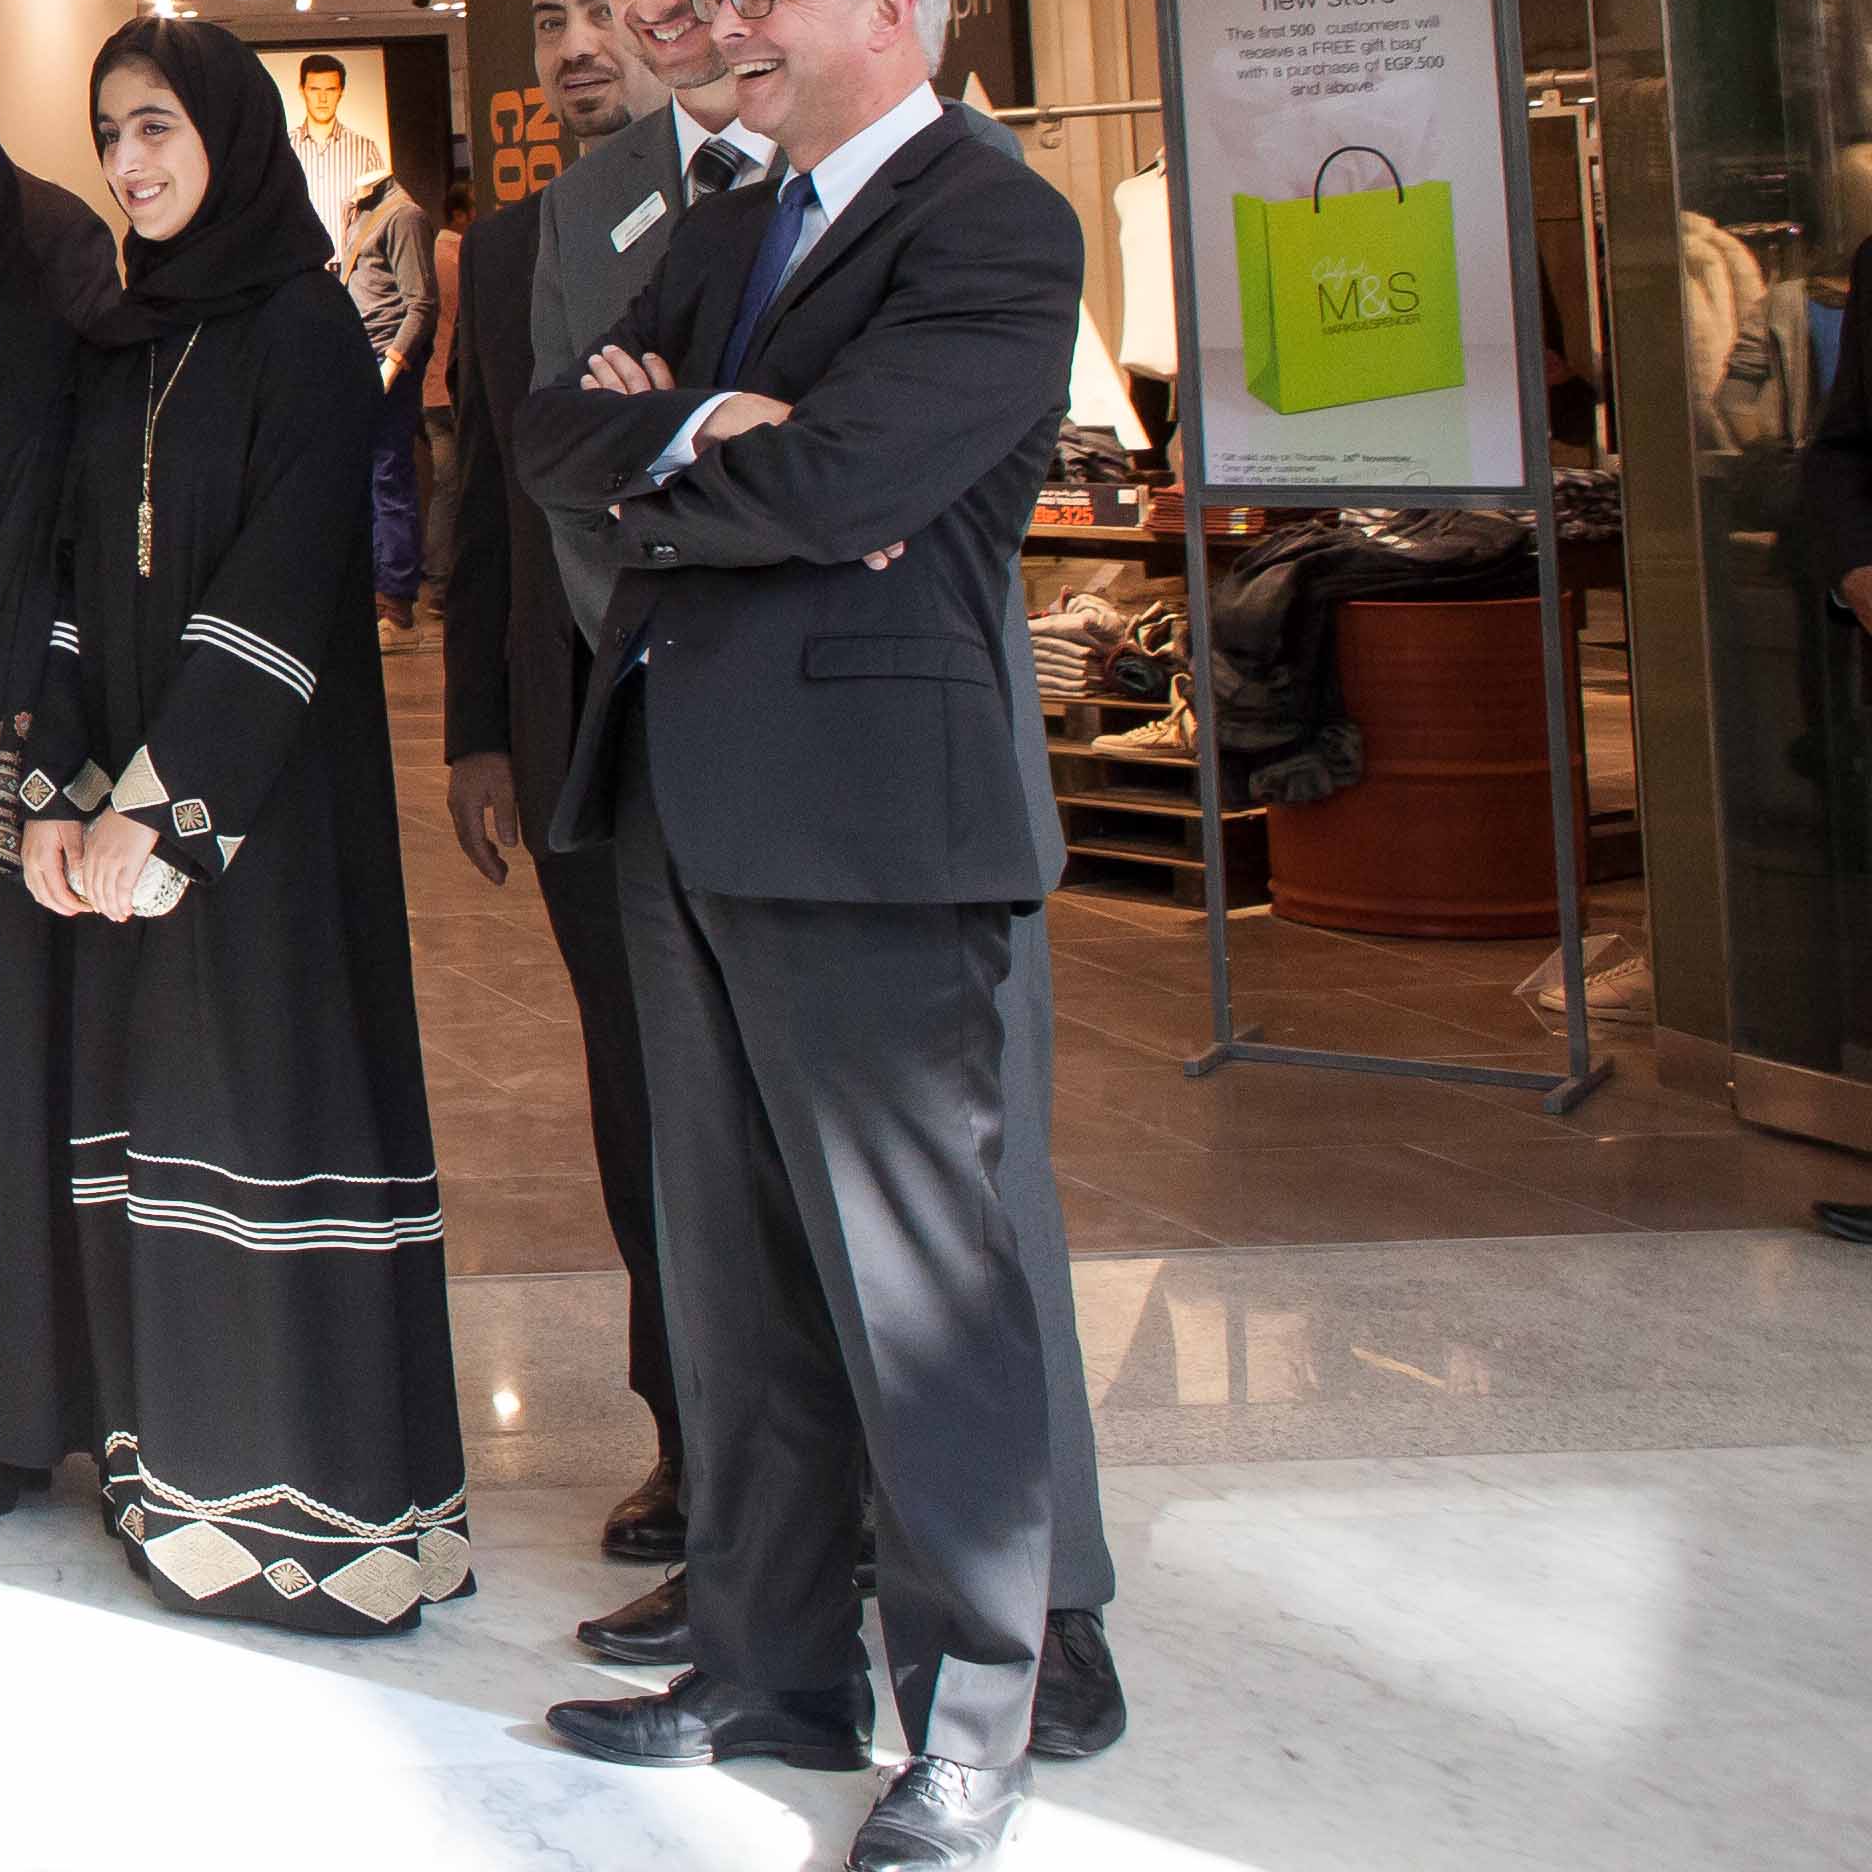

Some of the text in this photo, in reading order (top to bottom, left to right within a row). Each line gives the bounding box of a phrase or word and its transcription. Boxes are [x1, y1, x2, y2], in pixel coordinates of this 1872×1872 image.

[1224, 27, 1255, 41] The
[1287, 22, 1316, 37] 500
[1326, 17, 1409, 36] customers
[1415, 14, 1441, 29] will
[1238, 45, 1294, 60] receive
[1297, 45, 1308, 57] a
[1312, 39, 1357, 56] FREE
[1360, 36, 1385, 56] gift
[1236, 64, 1269, 80] with
[1273, 66, 1282, 79] a
[1286, 59, 1360, 80] purchase
[1364, 57, 1380, 74] of
[1290, 82, 1320, 97] and
[1317, 270, 1420, 324] M&S
